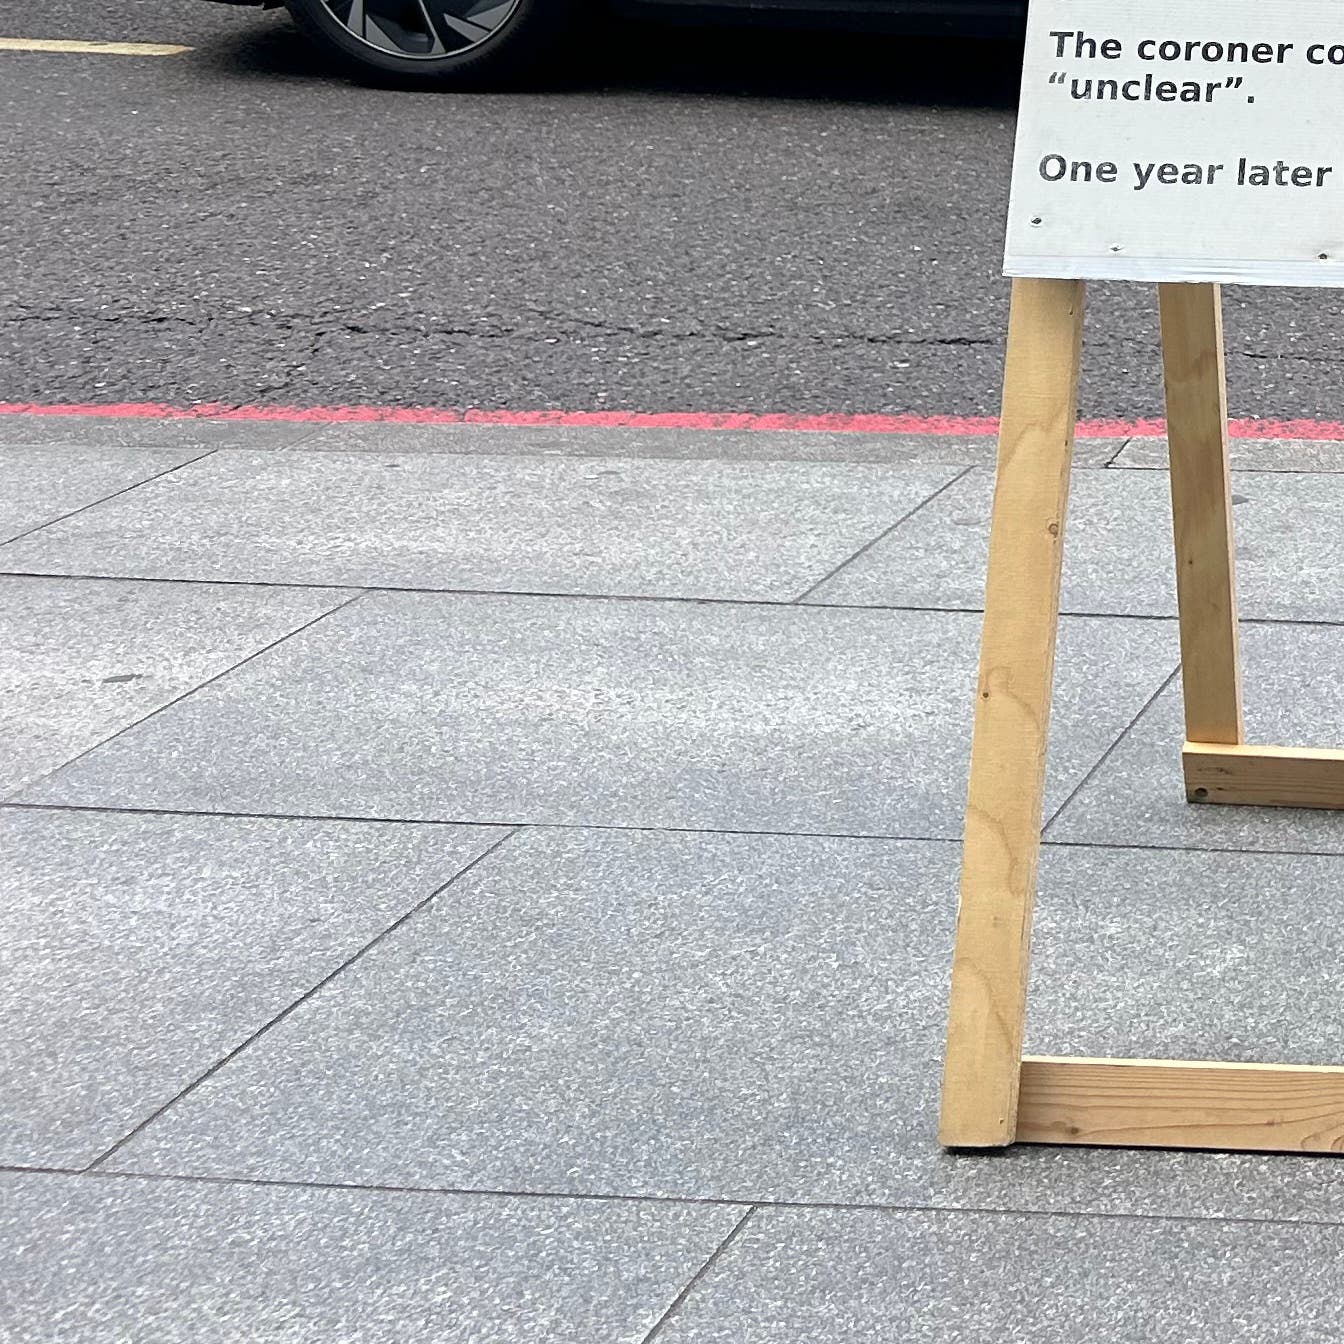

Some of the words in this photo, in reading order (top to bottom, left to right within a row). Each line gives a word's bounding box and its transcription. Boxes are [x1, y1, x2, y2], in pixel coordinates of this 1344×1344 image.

[1049, 31, 1122, 59] The
[1138, 40, 1293, 63] coroner
[1039, 154, 1117, 182] One
[1133, 163, 1223, 190] year
[1237, 158, 1332, 187] later
